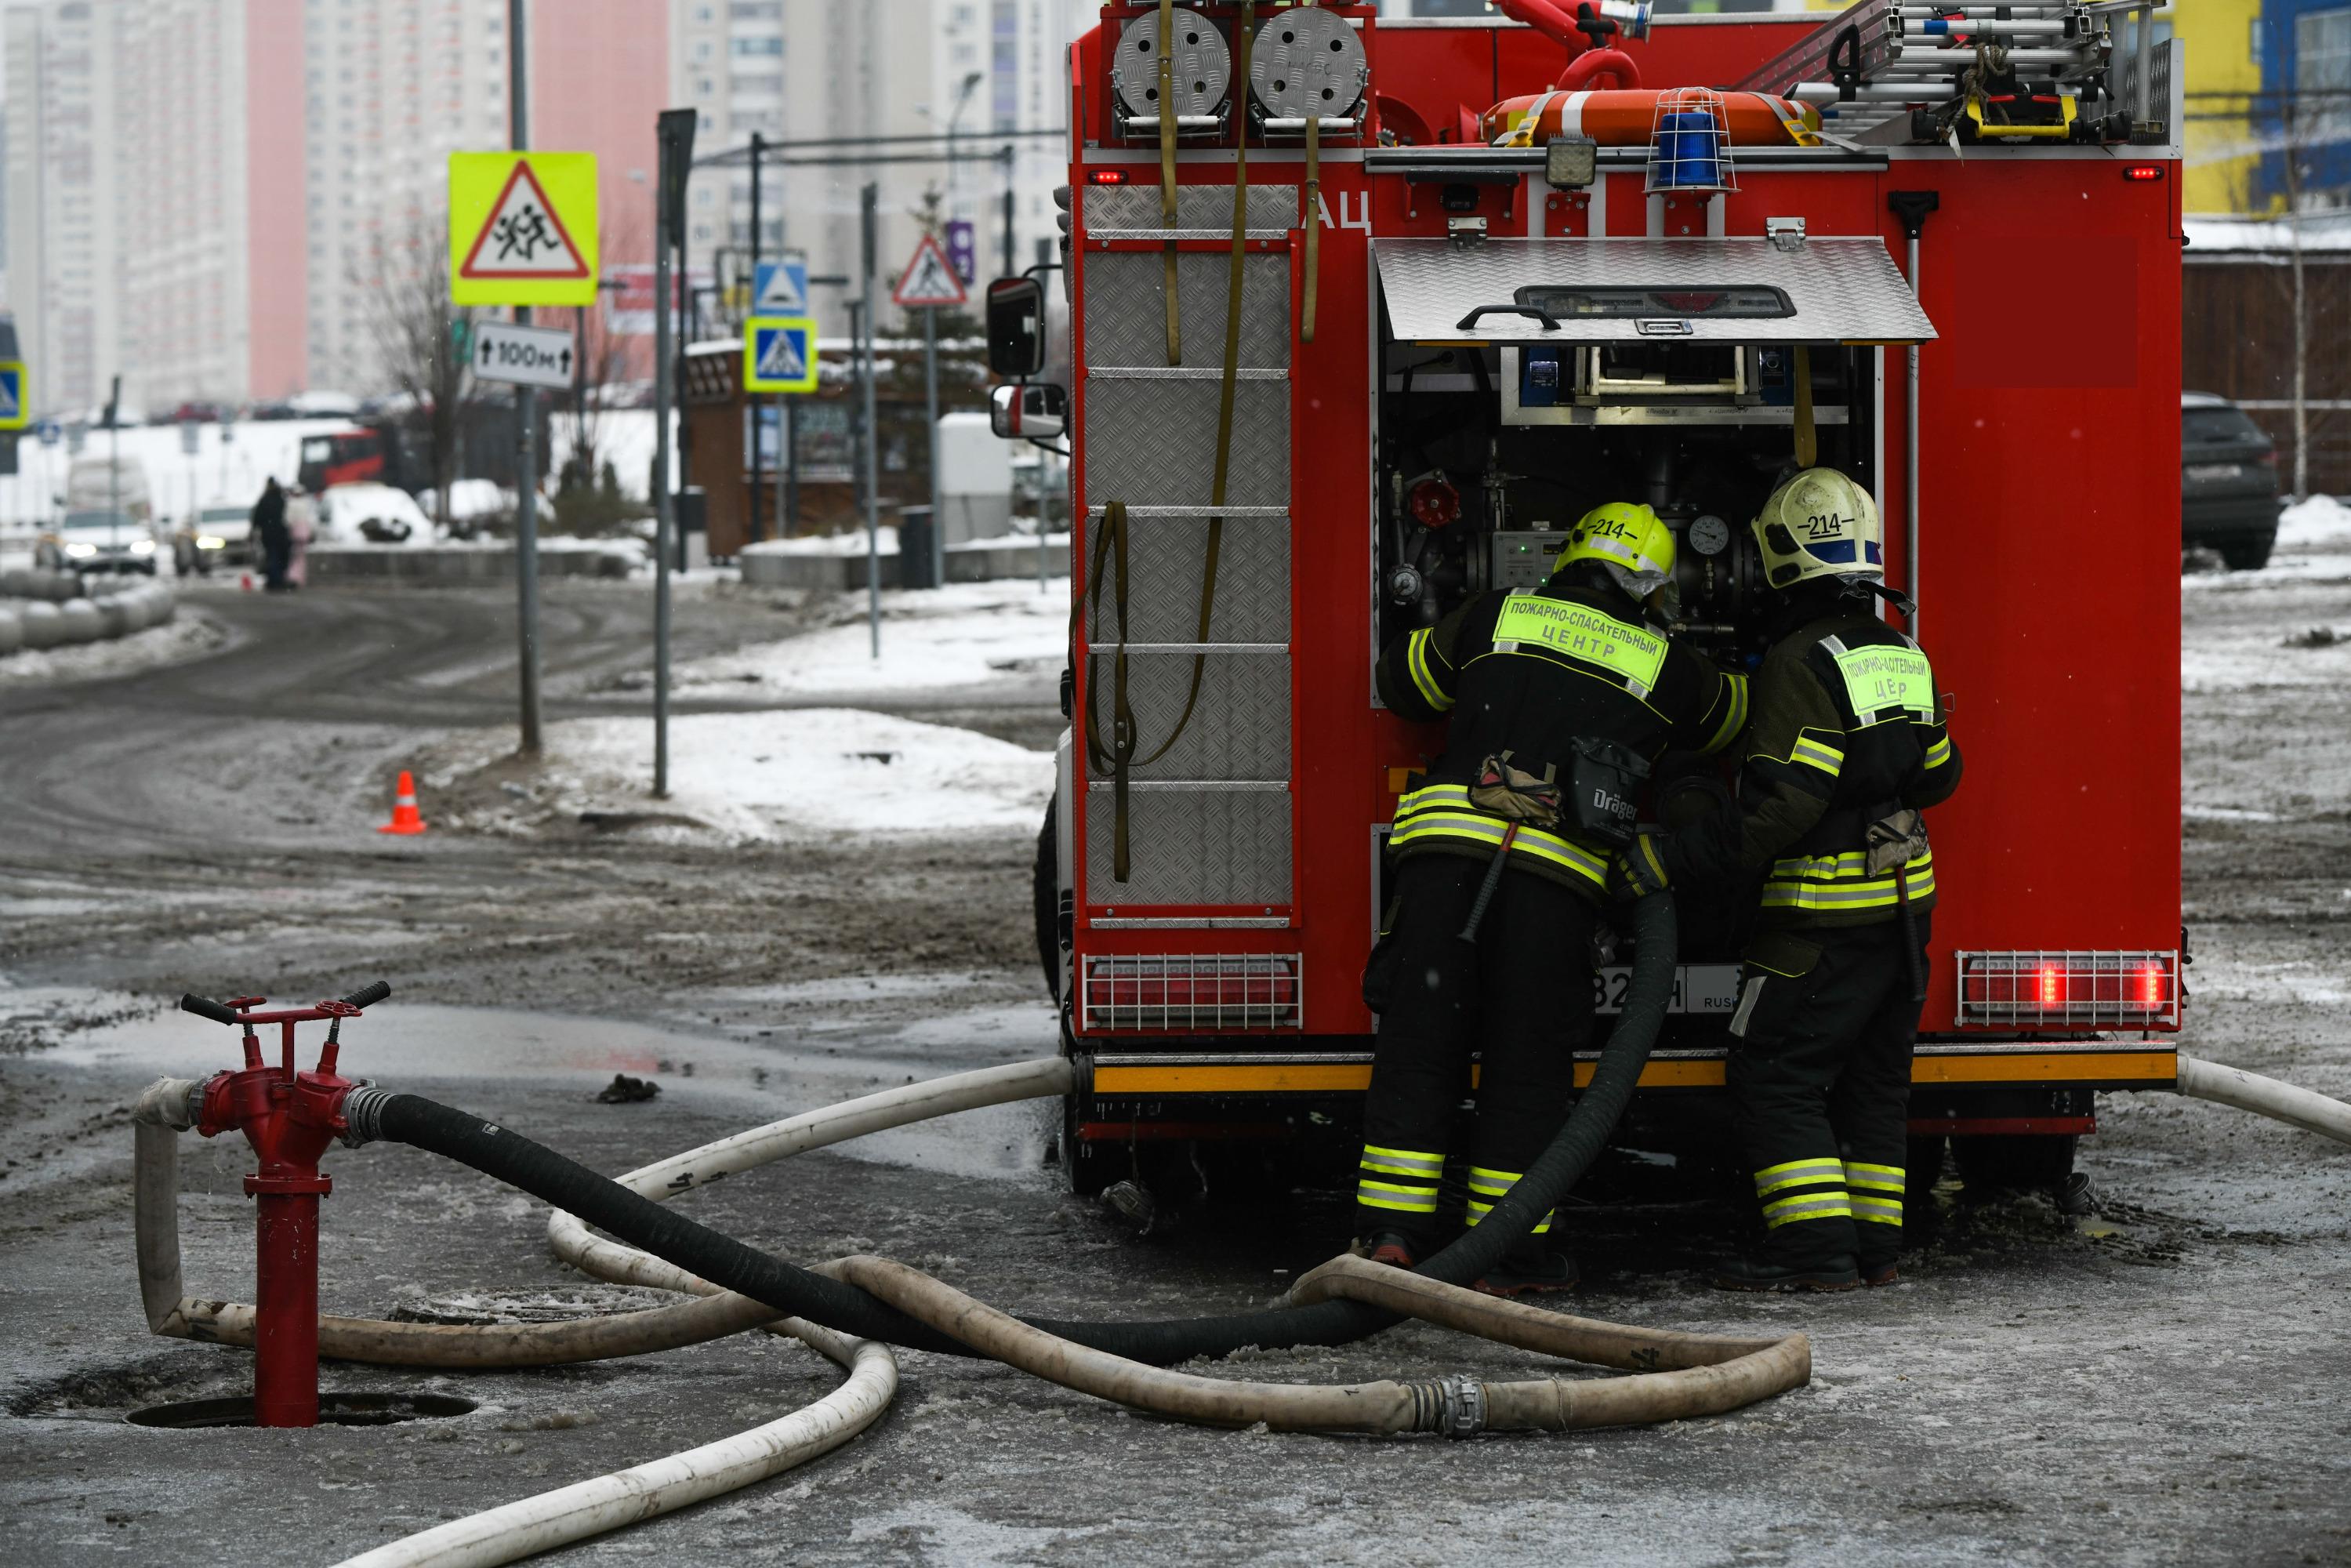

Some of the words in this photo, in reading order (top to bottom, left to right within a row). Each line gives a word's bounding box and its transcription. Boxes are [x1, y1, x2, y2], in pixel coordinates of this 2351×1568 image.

[499, 341, 555, 369] 100м
[1510, 601, 1660, 658] ПОЖАРНО-СПАСАТЕЛЬНЫЙ
[1542, 625, 1616, 658] ЦЕНТР
[1593, 788, 1638, 822] Dräger
[1704, 998, 1731, 1008] RUS
